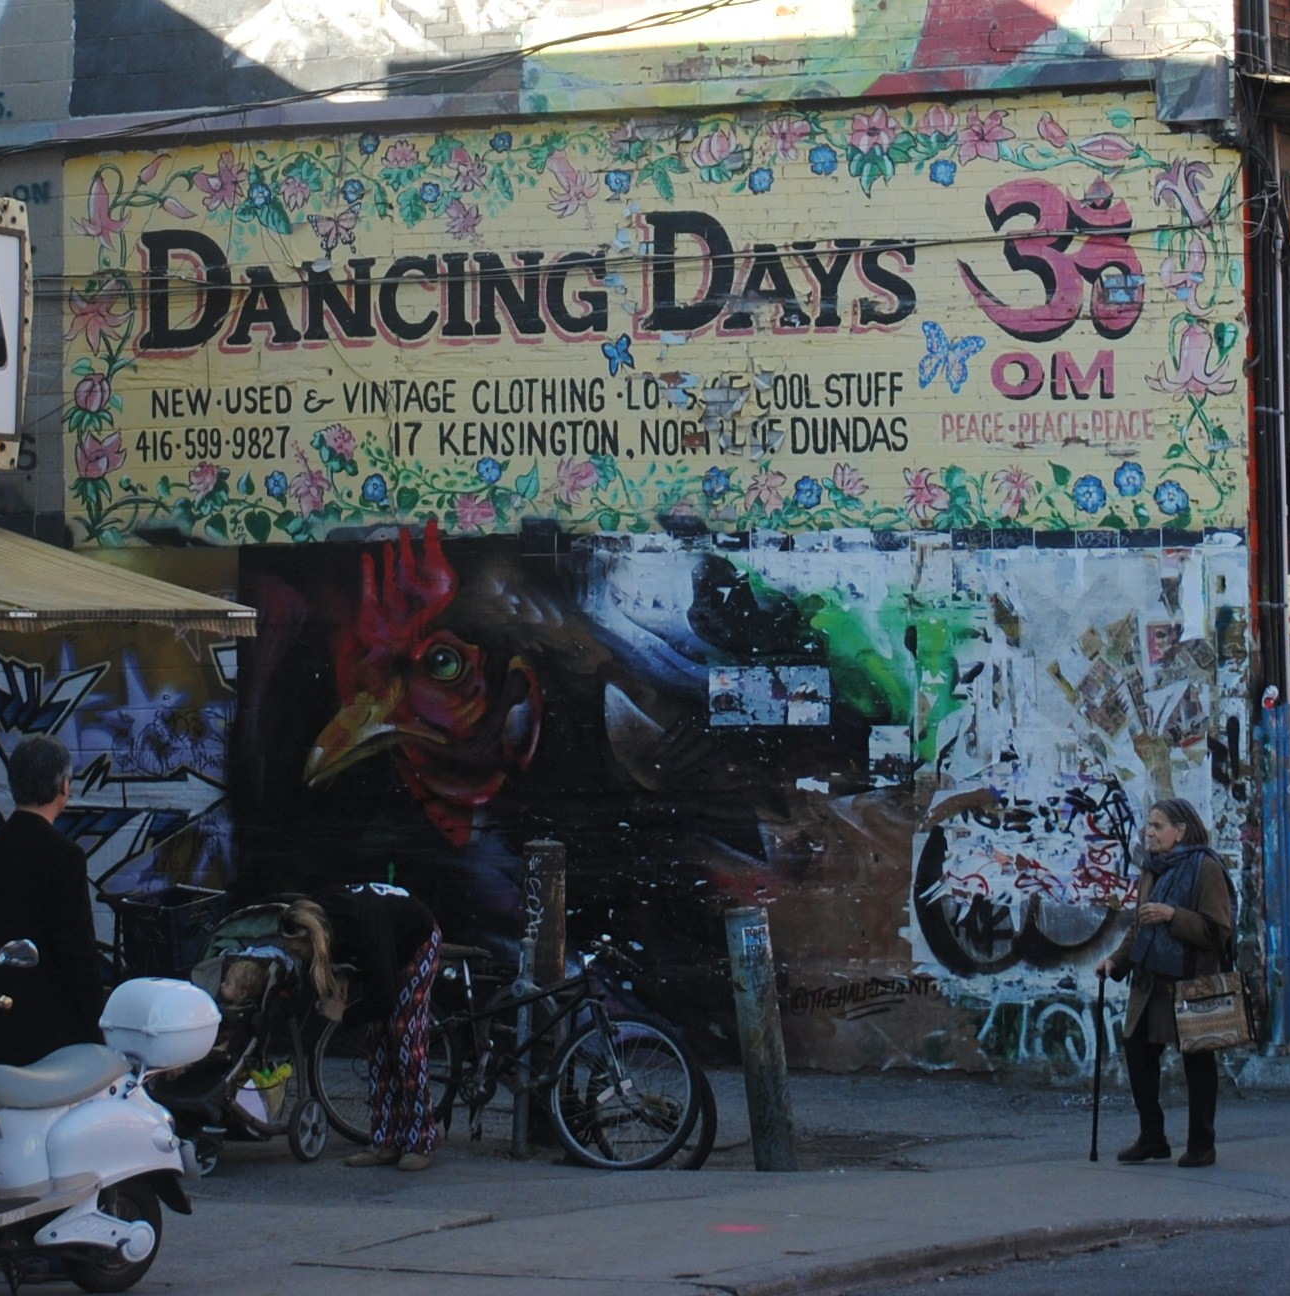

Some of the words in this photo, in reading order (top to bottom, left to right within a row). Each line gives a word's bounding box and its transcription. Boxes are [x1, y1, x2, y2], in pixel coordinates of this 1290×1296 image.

[136, 229, 611, 356] DANCING
[634, 211, 917, 338] DAYS
[151, 385, 212, 419] NEW
[225, 382, 292, 417] USED
[304, 389, 334, 414] &
[342, 377, 456, 416] VINTAGE
[472, 375, 606, 416] CLOTHING
[626, 374, 699, 412] LOS
[824, 371, 904, 409] STUFF
[990, 349, 1115, 400] OM
[392, 420, 423, 458] 17
[790, 416, 909, 455] DUNDAS
[940, 410, 1005, 443] PEACE
[1091, 407, 1155, 441] PEACE
